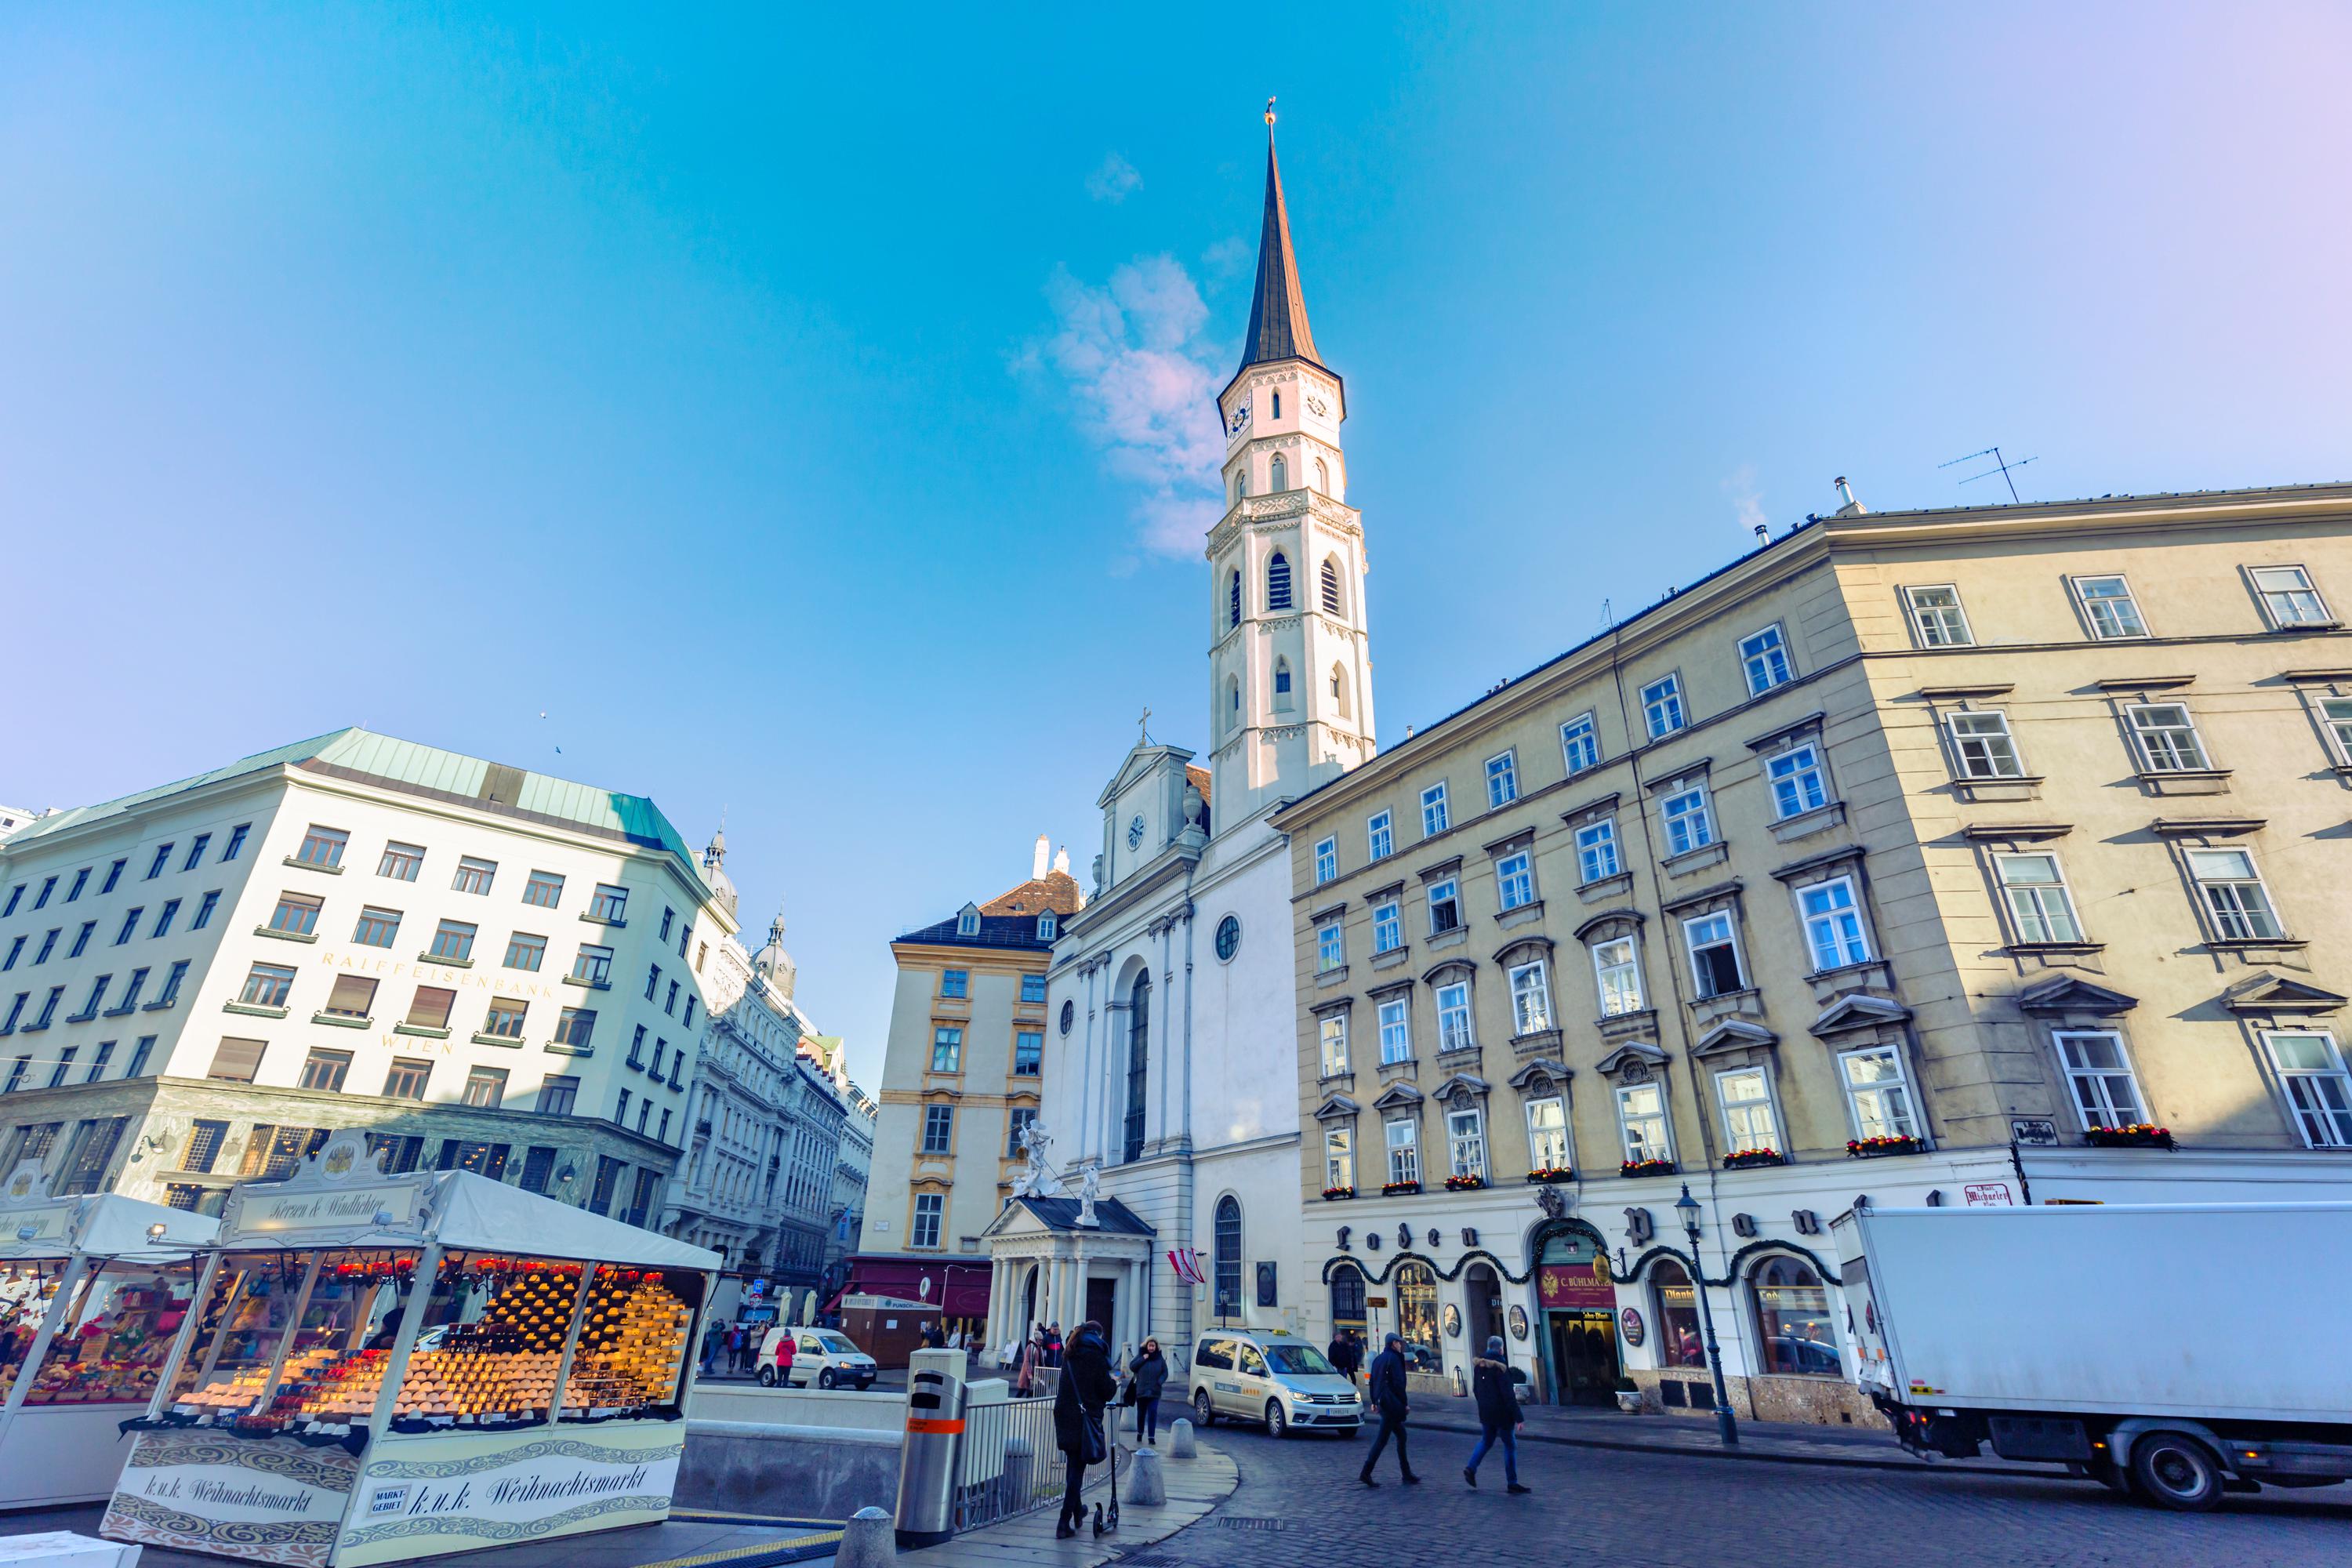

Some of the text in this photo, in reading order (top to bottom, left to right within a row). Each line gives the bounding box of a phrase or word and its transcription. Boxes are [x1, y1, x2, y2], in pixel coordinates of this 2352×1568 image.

[321, 952, 553, 998] RAIFFEISENBANK
[382, 1034, 454, 1055] WIEN
[269, 1193, 387, 1219] Kerzen & Windlichter
[1967, 1190, 2008, 1202] Michaeler
[1335, 1222, 1479, 1251] Loden
[1560, 1278, 1568, 1287] C.
[144, 1475, 313, 1512] k.u.k. Weihnachtsmarkt
[376, 1490, 406, 1501] MARKT-
[408, 1465, 648, 1515] k.u.k. Weihnachtsmarkt
[372, 1501, 401, 1512] GEBIET
